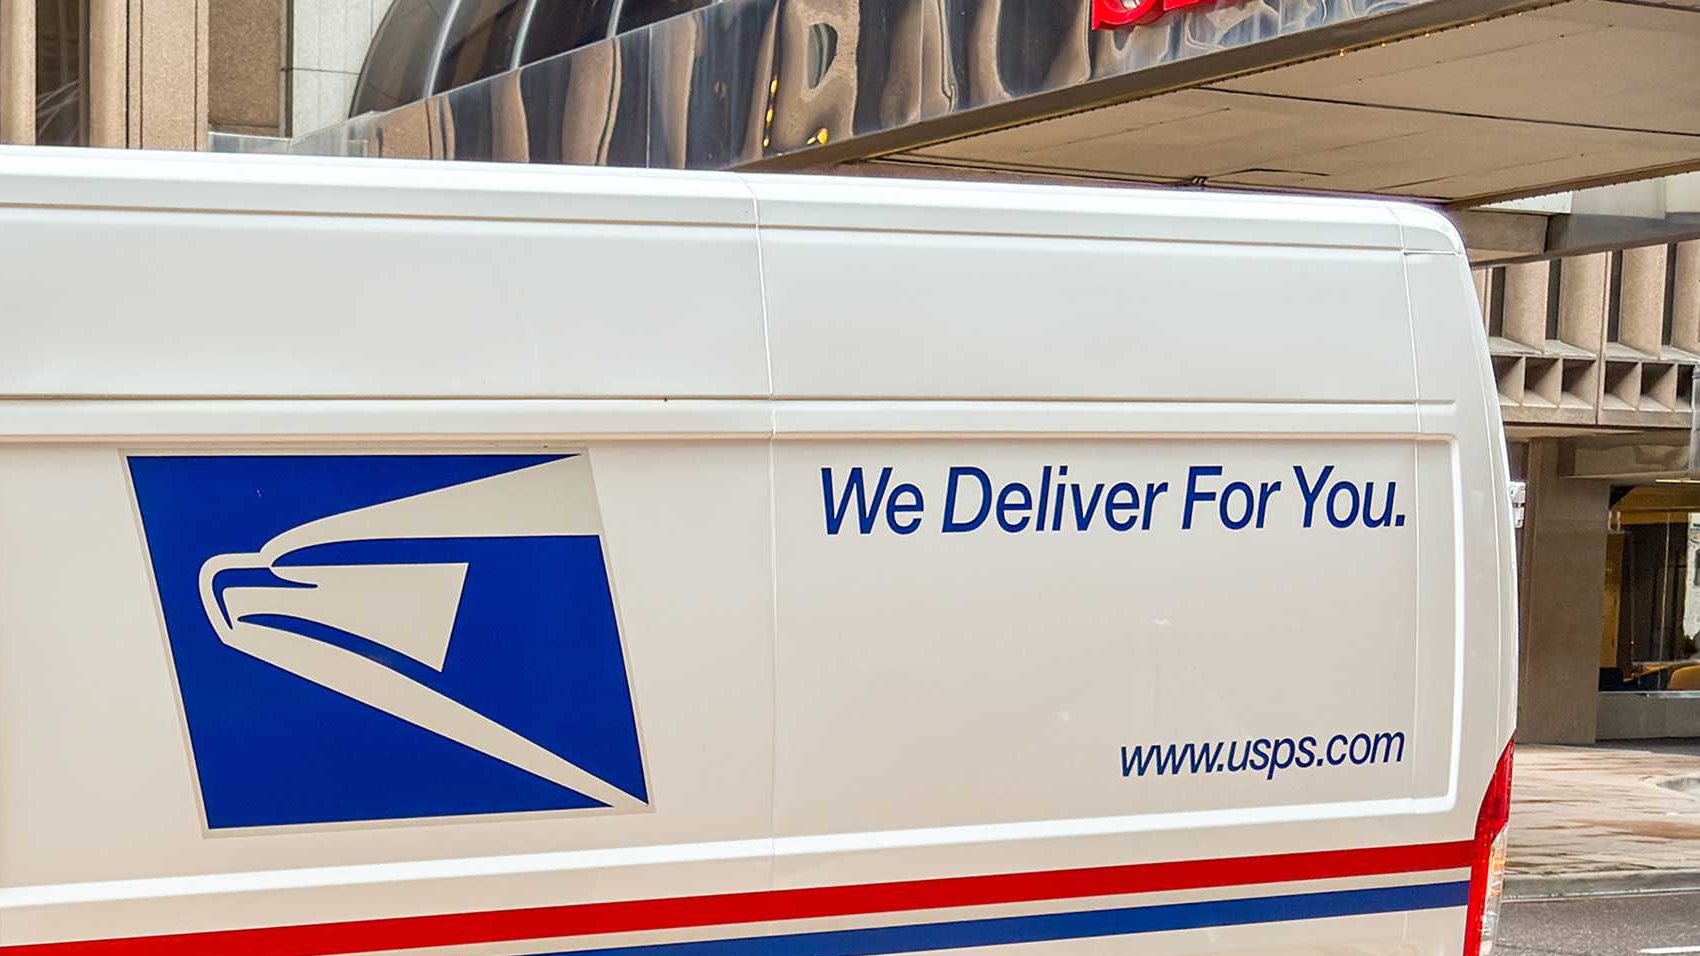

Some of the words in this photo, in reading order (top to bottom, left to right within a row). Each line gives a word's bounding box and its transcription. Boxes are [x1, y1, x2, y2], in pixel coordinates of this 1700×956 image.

[821, 467, 924, 535] We
[941, 465, 1168, 533] Deliver
[1182, 466, 1281, 529] For
[1294, 466, 1404, 528] You.
[1122, 733, 1404, 778] www.usps.com
